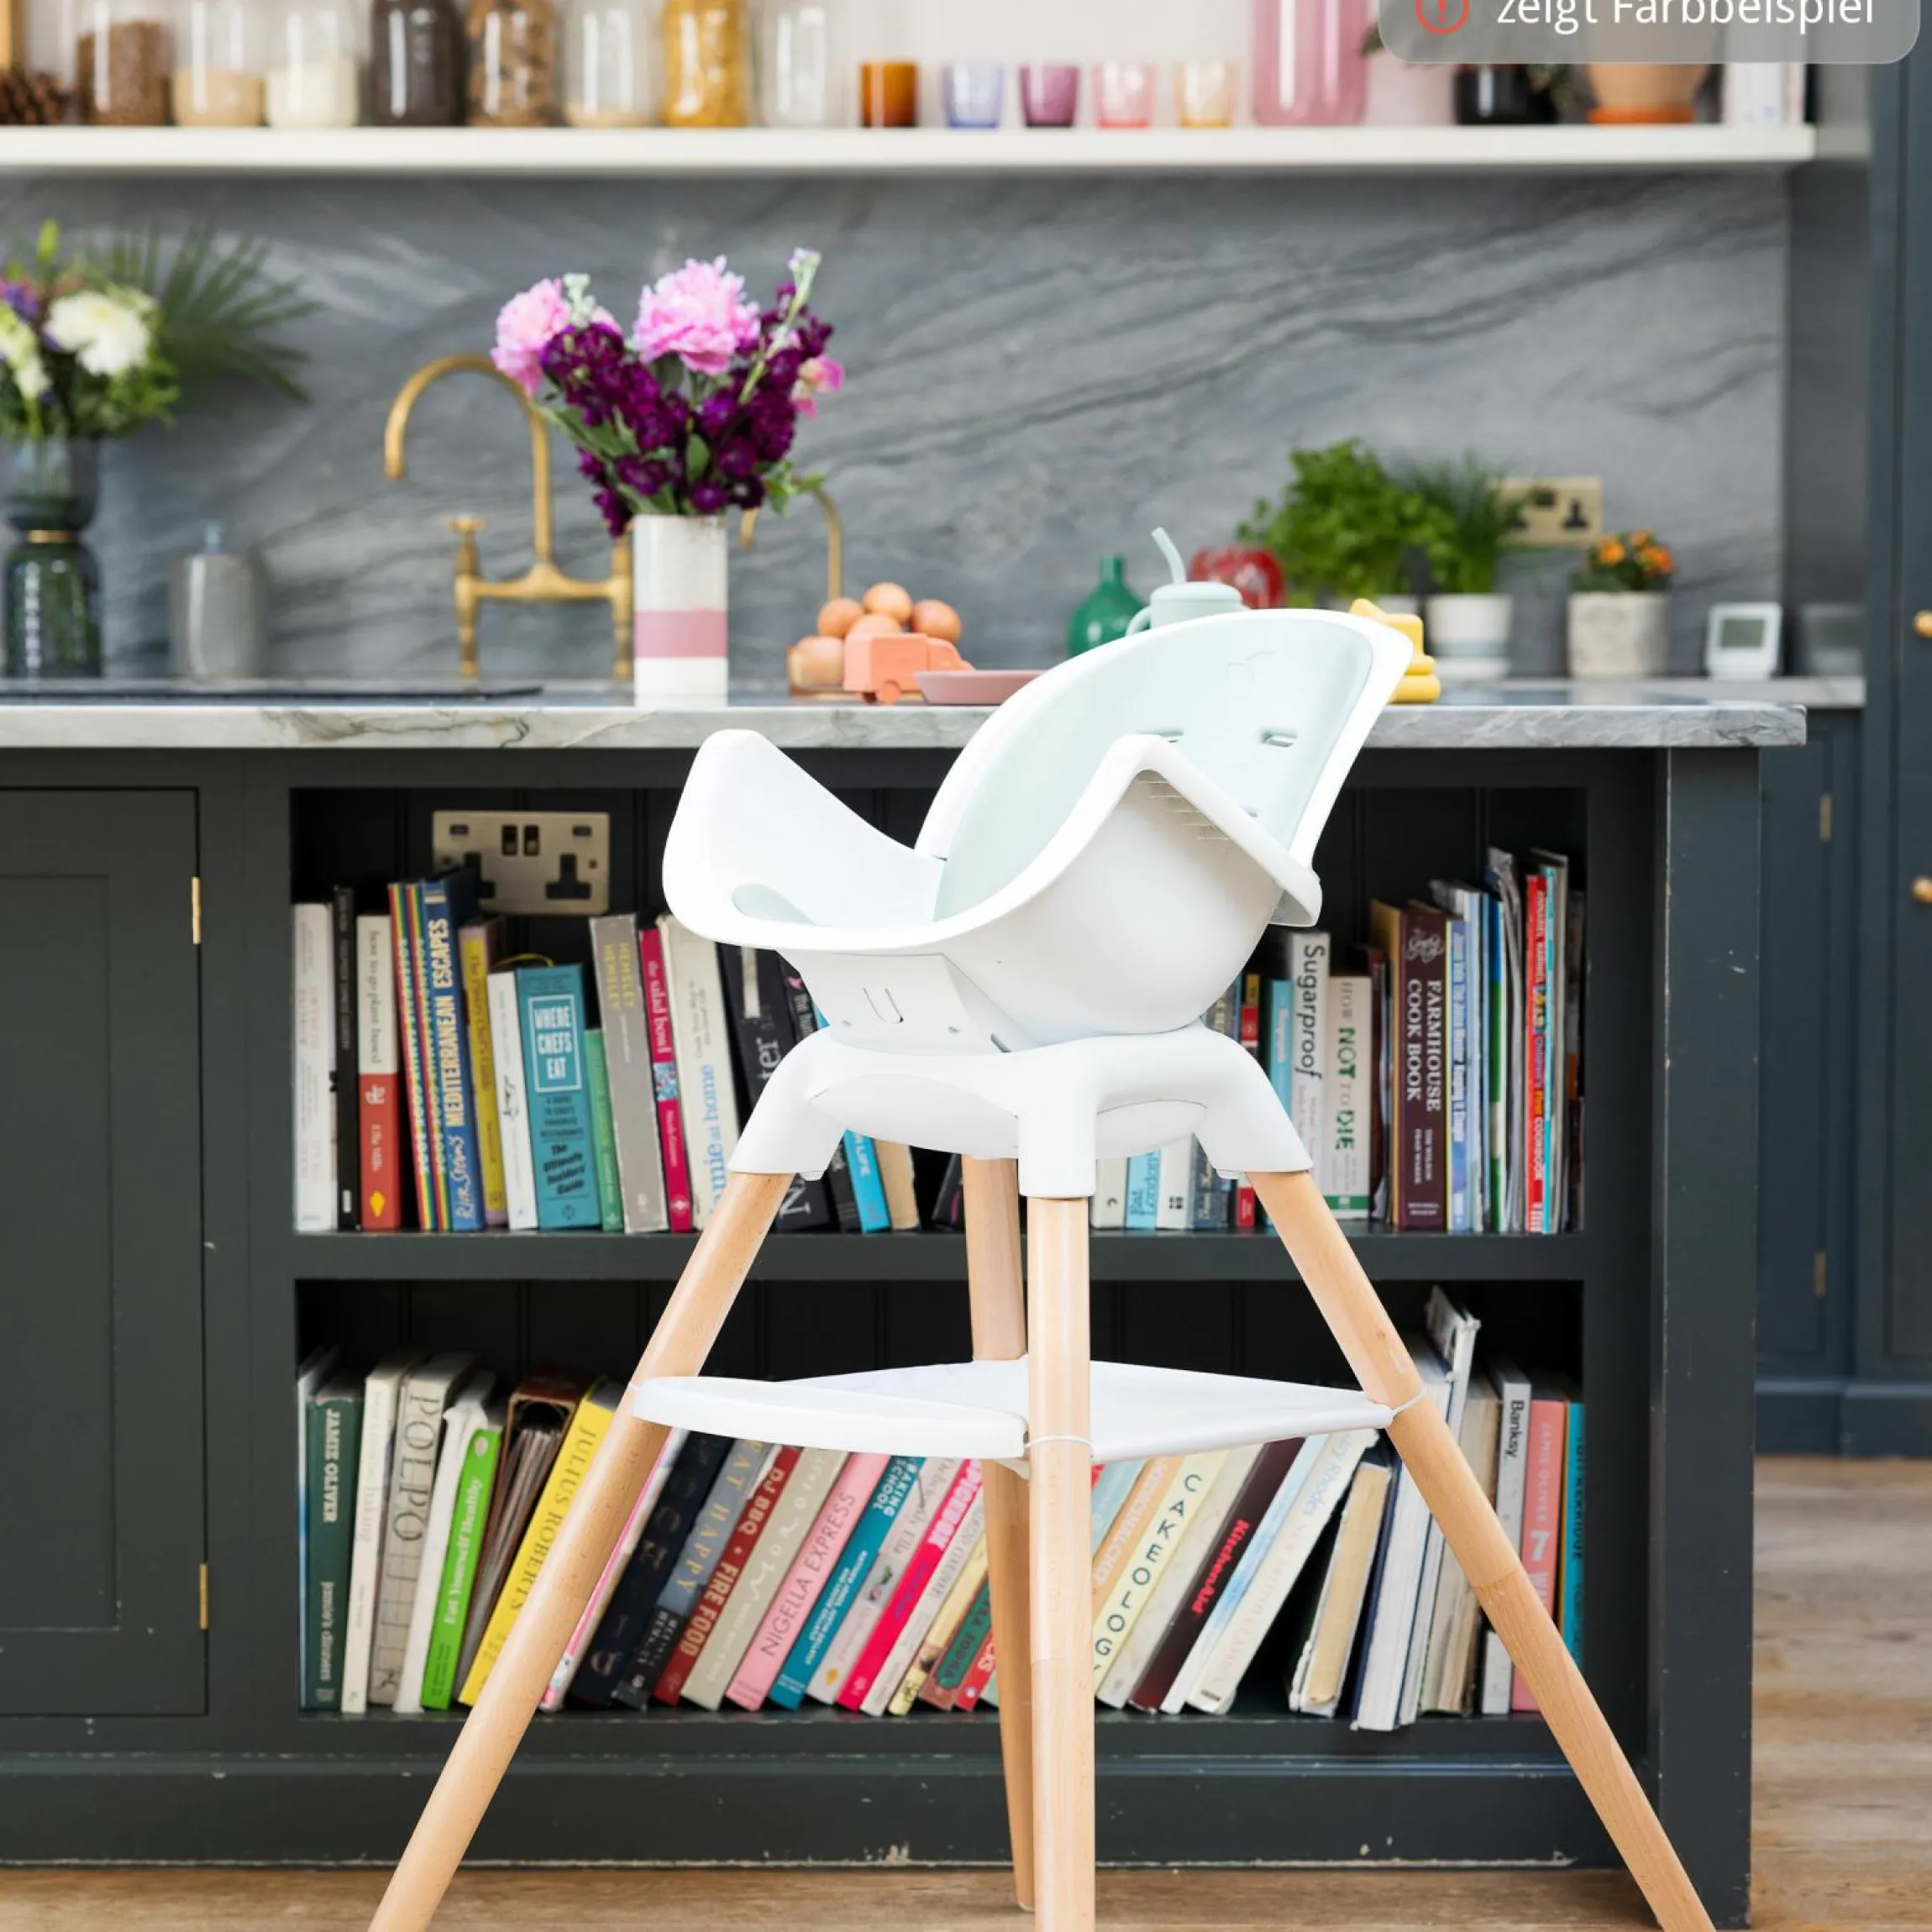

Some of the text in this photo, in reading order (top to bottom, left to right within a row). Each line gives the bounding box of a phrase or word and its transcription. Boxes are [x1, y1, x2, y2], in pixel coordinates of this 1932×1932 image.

[367, 974, 380, 990] go
[603, 944, 620, 1008] HEMSLEY
[618, 942, 635, 1008] HEMSLEY
[1341, 981, 1353, 1021] HOW
[428, 918, 465, 1127] MEDITERRANEAN ESCAPES
[534, 1006, 571, 1028] WHERE
[648, 960, 672, 1055] the salad bowl
[1295, 944, 1325, 1079] Sugarproof
[538, 1031, 572, 1053] CHEFS
[546, 1057, 567, 1080] EAT
[1338, 1027, 1356, 1079] NOT
[1407, 979, 1422, 1102] COOK BOOK
[1426, 980, 1442, 1112] FARMHOUSE
[702, 1064, 719, 1123] home
[1340, 1083, 1352, 1105] TO
[551, 1144, 567, 1155] The
[1335, 1110, 1355, 1150] DIE
[543, 1152, 583, 1173] Ultimate
[556, 1180, 584, 1195] Guide
[1509, 1399, 1525, 1458] Banksy
[323, 1409, 341, 1523] JAMIE OLIVER
[391, 1394, 442, 1543] POLPO
[1303, 1462, 1341, 1517] Rhodes
[1535, 1422, 1551, 1523] JAMIE OLIVER
[511, 1425, 597, 1612] JULIUS ROBERTS
[738, 1494, 771, 1536] BBQ
[444, 1478, 484, 1625] Eat Yourself Healthy
[676, 1503, 730, 1589] HAPPY
[761, 1577, 816, 1656] NIGELLA
[802, 1493, 858, 1572] EXPRESS
[1191, 1519, 1251, 1617] KitchenAid
[1530, 1530, 1551, 1562] 7
[705, 1562, 739, 1606] FIRE
[679, 1605, 714, 1656] FOOD
